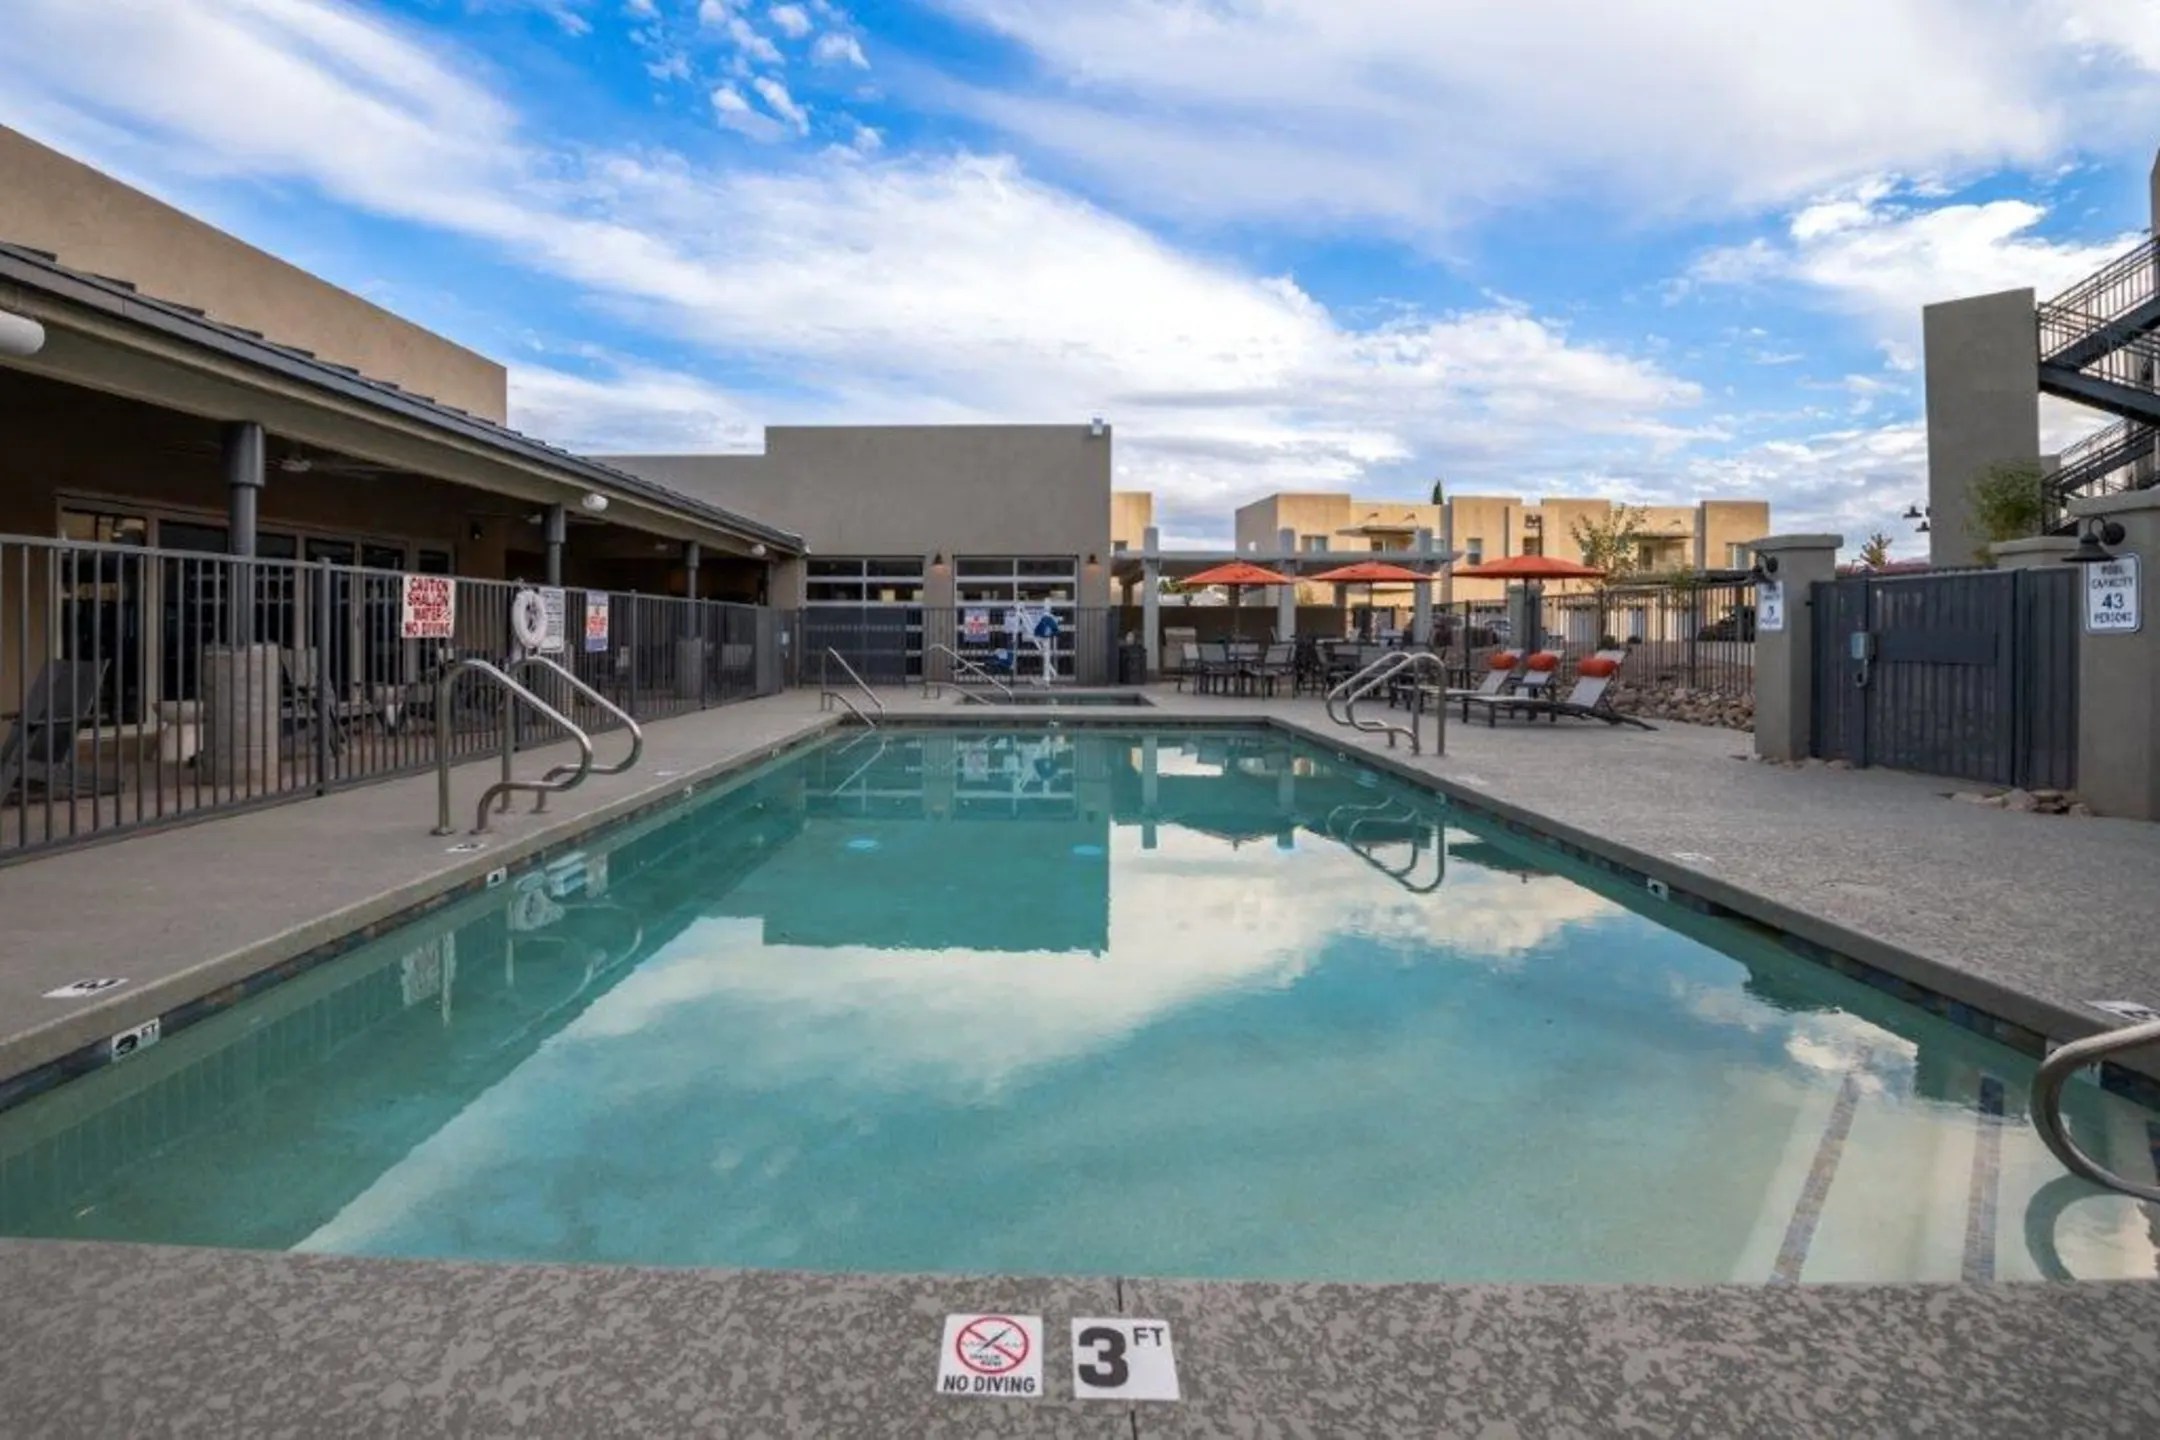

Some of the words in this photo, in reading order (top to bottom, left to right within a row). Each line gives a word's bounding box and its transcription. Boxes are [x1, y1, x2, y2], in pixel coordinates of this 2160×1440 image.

[2101, 592, 2125, 609] 43
[1078, 1326, 1130, 1388] 3
[1133, 1327, 1164, 1347] FT
[943, 1374, 968, 1392] NO
[974, 1375, 1036, 1393] DIVING
